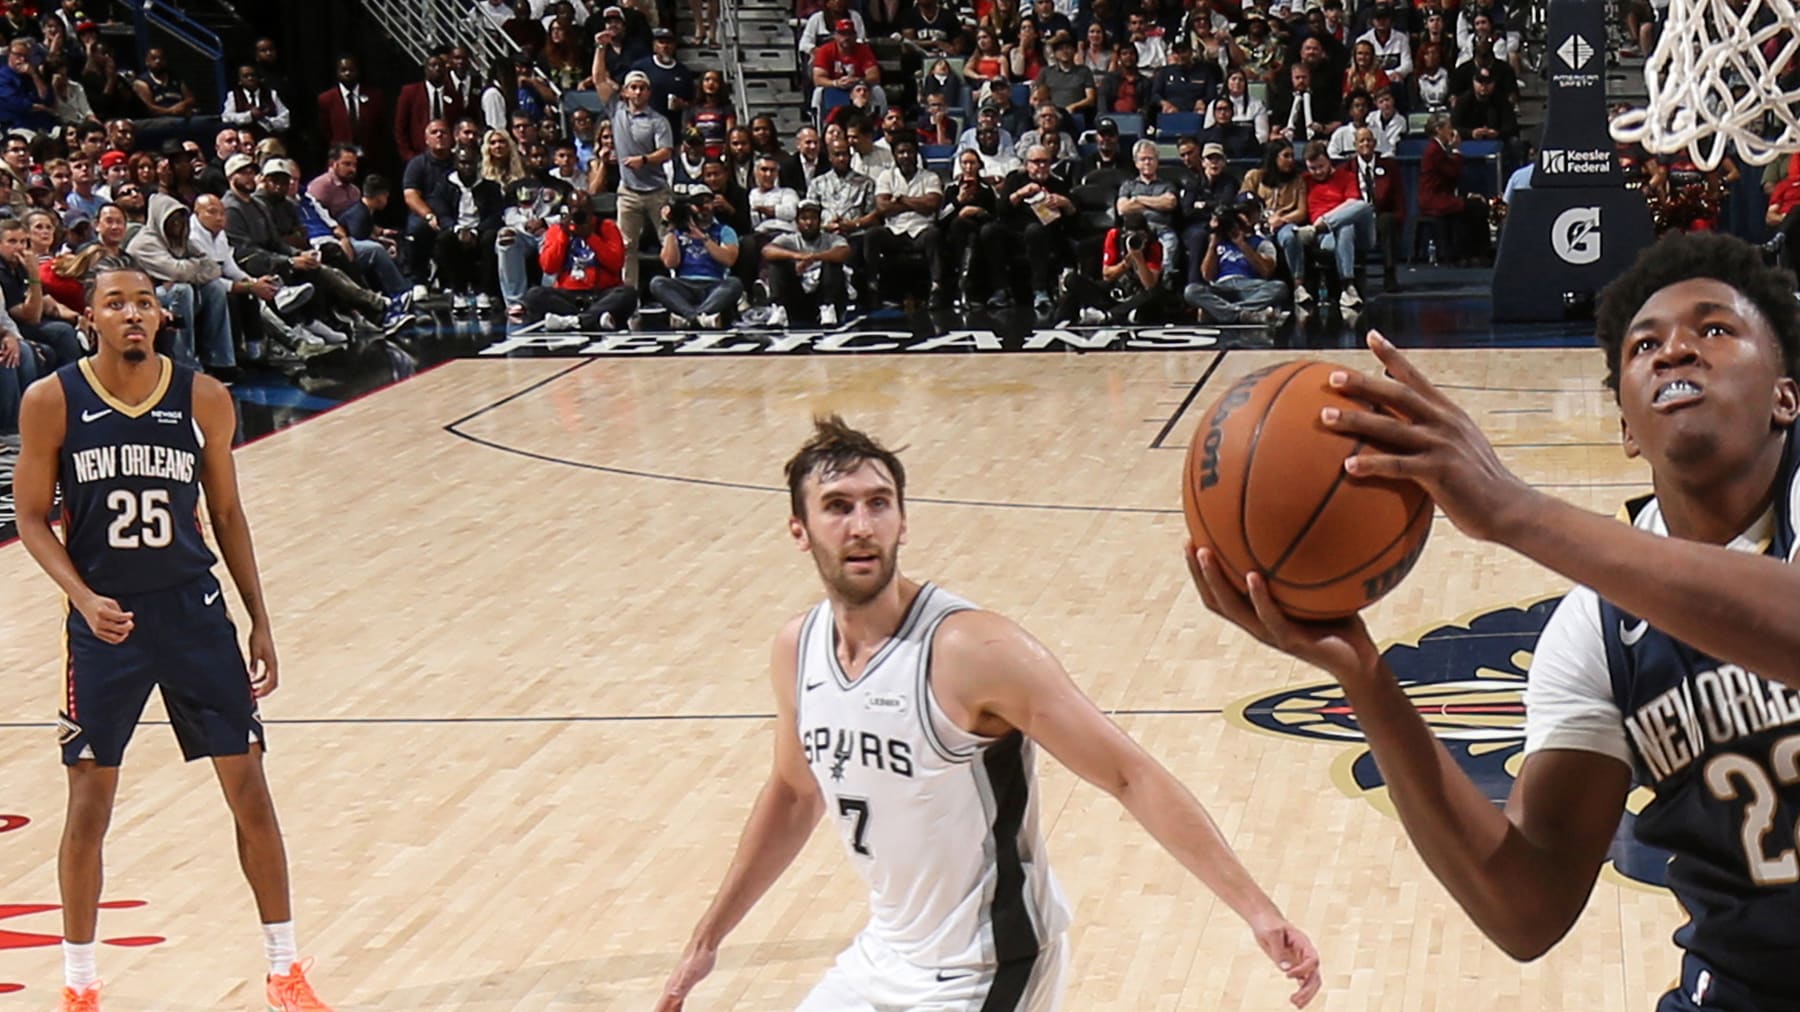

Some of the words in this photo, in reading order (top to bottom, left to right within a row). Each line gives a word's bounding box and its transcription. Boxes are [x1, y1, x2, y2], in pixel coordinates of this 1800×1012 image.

[1567, 149, 1611, 161] Keesler
[1567, 161, 1611, 173] Federal
[1552, 206, 1601, 265] G
[478, 328, 1222, 355] PELICANS
[73, 446, 116, 484] NEW
[120, 444, 195, 484] ORLEANS
[106, 488, 174, 549] 25
[1624, 675, 1705, 783] NEW
[837, 795, 871, 858] 7
